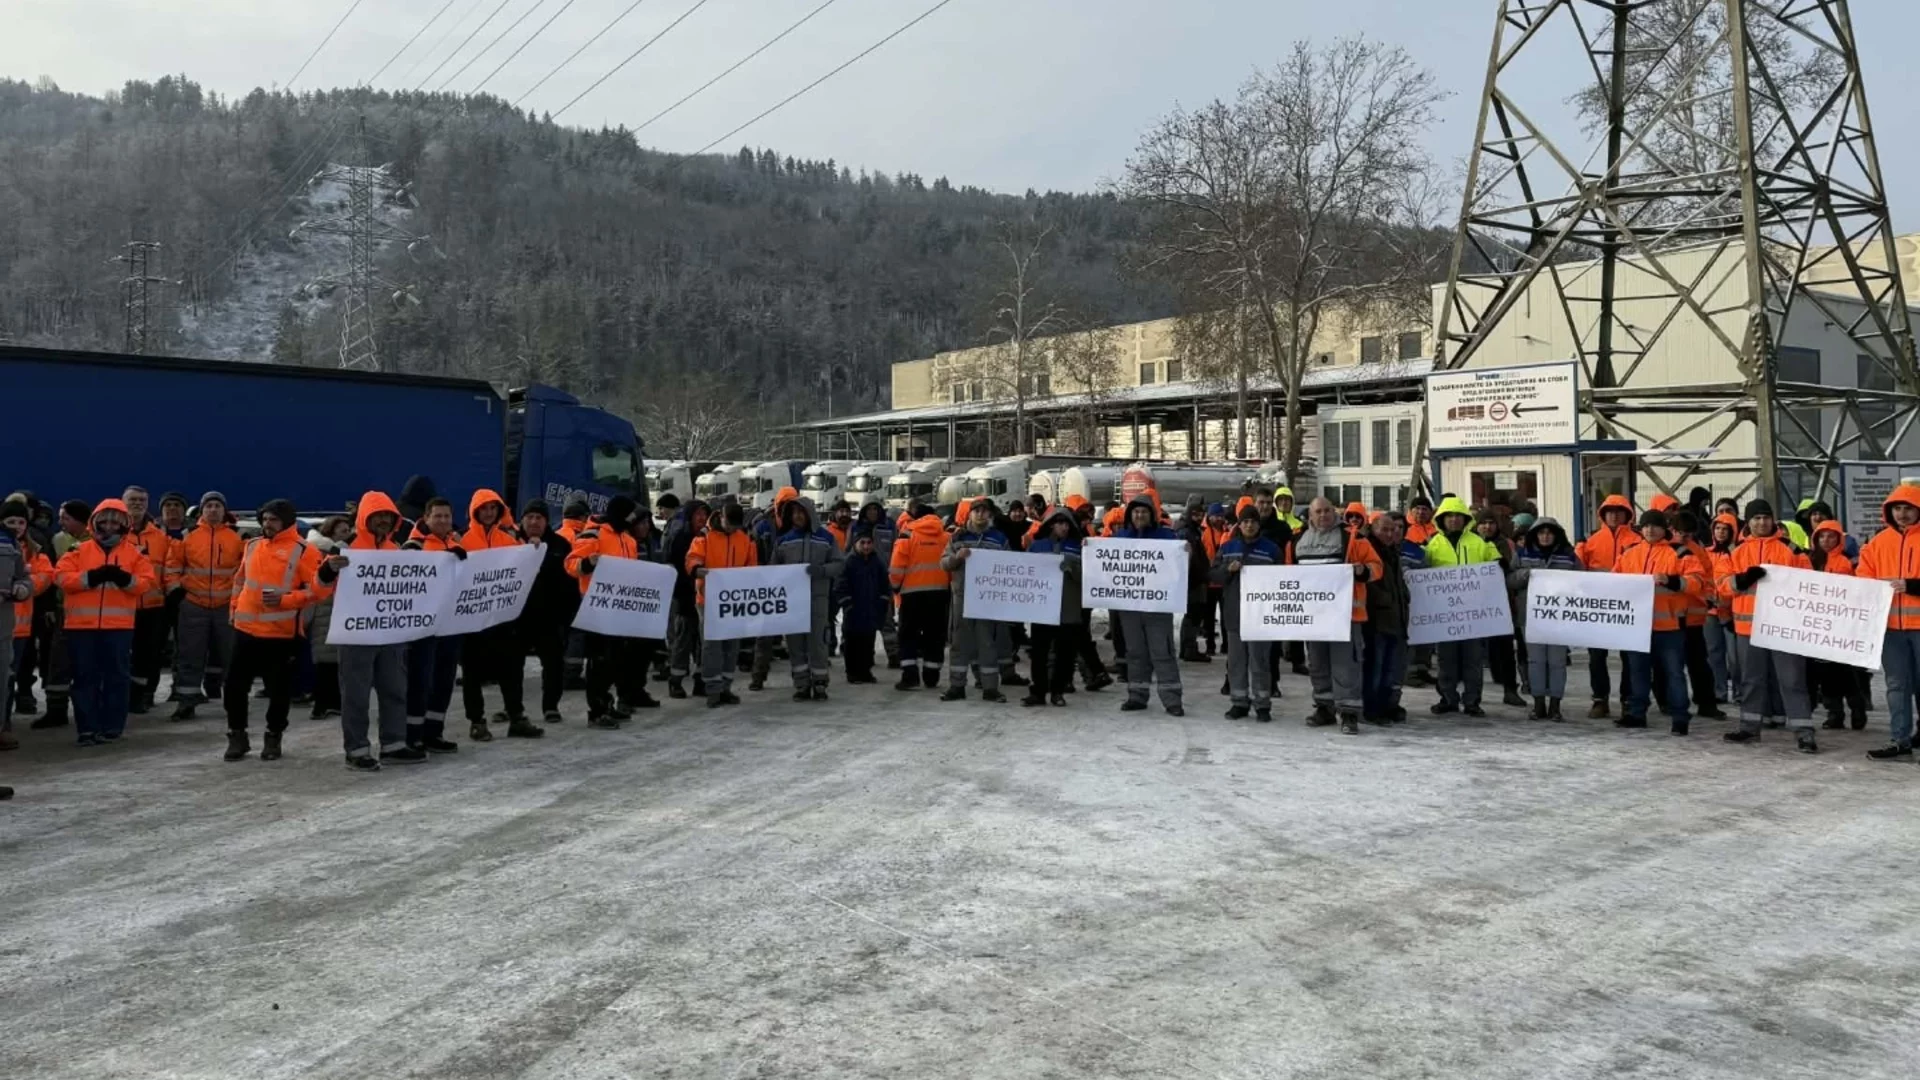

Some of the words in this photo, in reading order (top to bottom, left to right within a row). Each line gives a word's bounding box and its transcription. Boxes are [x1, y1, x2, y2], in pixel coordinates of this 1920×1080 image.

[1096, 549, 1120, 560] ЗАД
[1124, 549, 1165, 561] ВСЯКА
[357, 565, 386, 579] ЗАД
[390, 565, 437, 578] ВСЯКА
[992, 564, 1026, 576] ДНЕС
[1102, 562, 1157, 574] МАШИНА
[1460, 567, 1477, 580] ДА
[1481, 565, 1496, 576] СЕ
[473, 568, 517, 585] НАШИТЕ
[1112, 575, 1145, 587] СТОИ
[363, 581, 427, 595] МАШИНА
[457, 588, 488, 604] ДЕЦА
[490, 580, 522, 596] СЪЩО
[595, 582, 613, 594] ТУК
[1279, 580, 1300, 590] БЕЗ
[1426, 581, 1480, 595] ГРИЖИМ
[1798, 581, 1820, 595] НЕ
[1823, 585, 1847, 600] НИ
[718, 586, 787, 602] ОСТАВКА
[978, 590, 1008, 601] УТРЕ
[1011, 590, 1034, 603] КОЙ
[1090, 586, 1168, 601] СЕМЕЙСТВО!
[1246, 592, 1336, 603] ПРОИЗВОДСТВО
[376, 599, 413, 612] СТОИ
[455, 600, 493, 616] РАСТАТ
[589, 595, 610, 608] ТУК
[1273, 603, 1304, 613] НЯМА
[1447, 596, 1464, 607] ЗА
[1536, 595, 1560, 607] ТУК
[1565, 595, 1634, 612] ЖИВЕЕМ,
[1773, 595, 1869, 621] ОСТАВЯЙТЕ
[718, 600, 788, 618] РИОСВ
[344, 614, 436, 630] СЕМЕЙСТВО!
[1263, 614, 1314, 626] БЪДЕЩЕ!
[1533, 608, 1558, 620] ТУК
[1562, 610, 1634, 625] РАБОТИМ!
[1802, 615, 1832, 631] БЕЗ
[1760, 623, 1865, 652] ПРЕПИТАНИЕ
